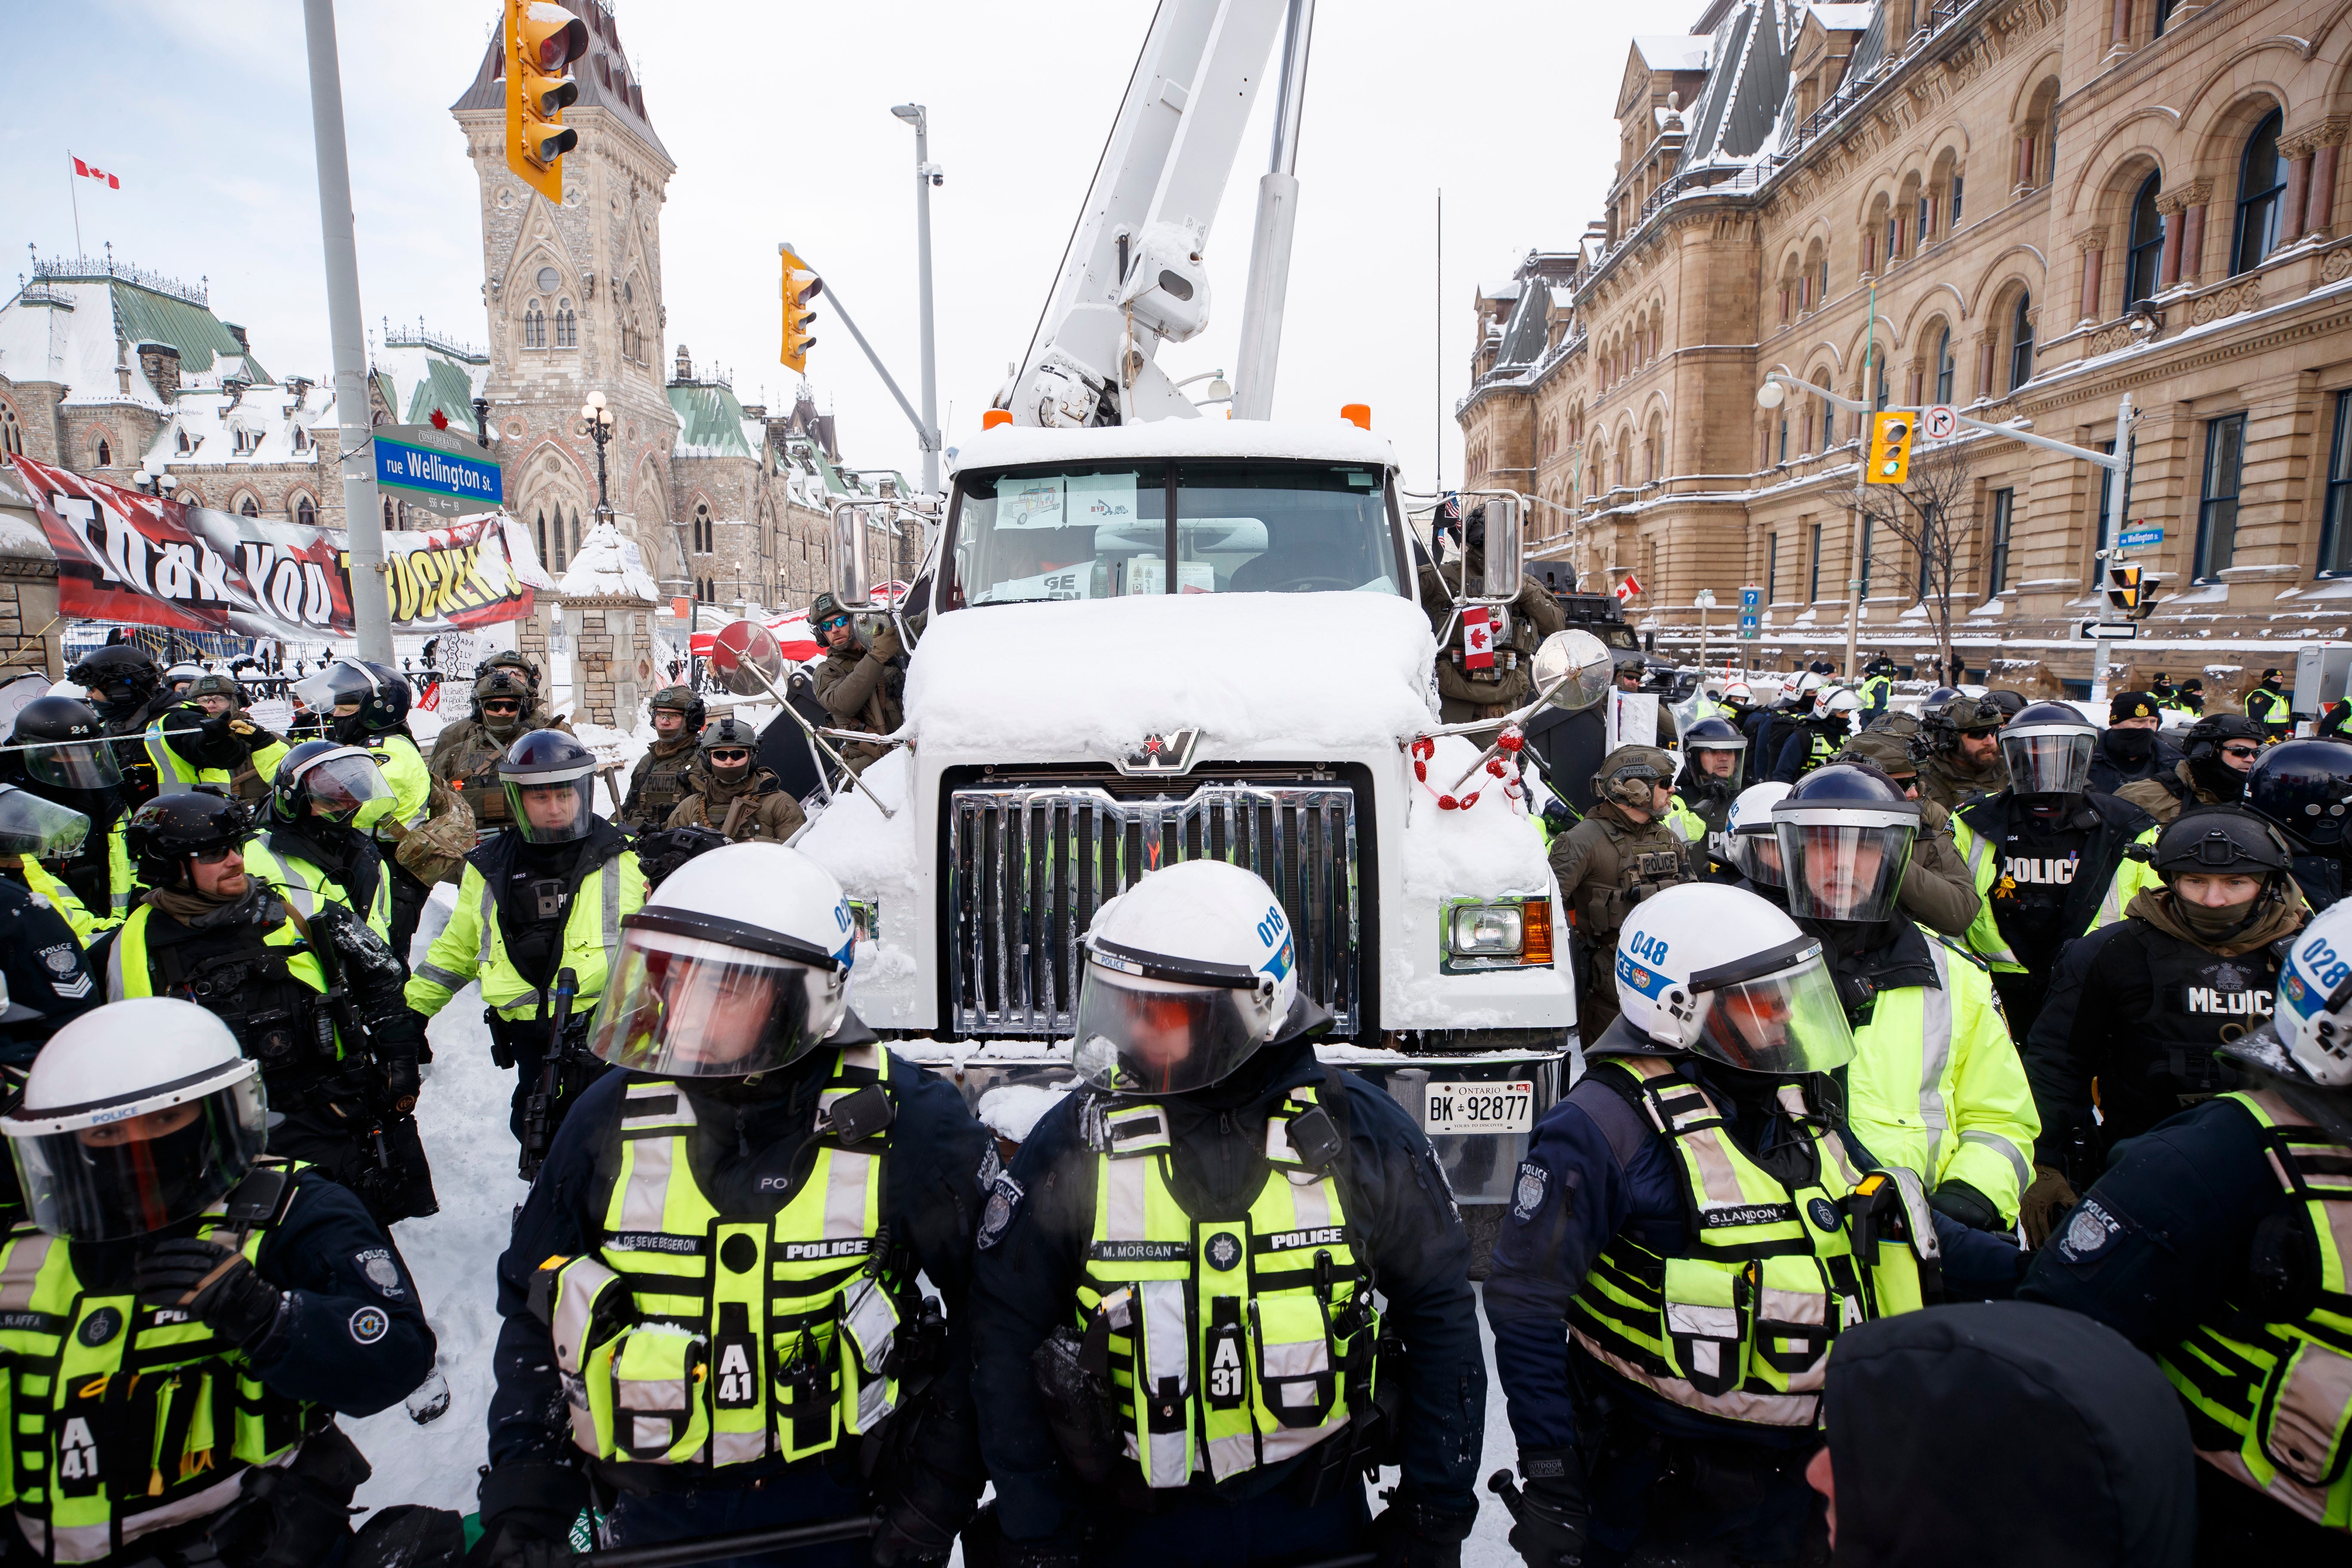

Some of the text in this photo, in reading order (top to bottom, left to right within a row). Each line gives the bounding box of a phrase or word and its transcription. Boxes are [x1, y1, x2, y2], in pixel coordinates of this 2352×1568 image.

[387, 459, 403, 475] rue
[406, 451, 480, 491] Wellington
[429, 497, 459, 511] 556 93
[2128, 533, 2153, 544] Wellington
[70, 725, 89, 735] 24
[646, 776, 676, 793] POLICE
[1645, 855, 1675, 872] POLICE
[2001, 855, 2079, 885] POLIC
[1257, 906, 1284, 948] 018
[39, 942, 72, 957] POLICE
[1630, 930, 1669, 966] 048
[1807, 943, 1821, 957] POLICE
[1101, 956, 1125, 971] POLICE
[2201, 965, 2252, 976] RCMP GRC
[2302, 937, 2350, 989] 028
[2189, 987, 2274, 1016] MEDIC
[1459, 1087, 1501, 1095] ONTARIO
[92, 1106, 138, 1124] POLICE
[1430, 1096, 1528, 1121] BK 92877
[977, 1138, 994, 1179] POLICE
[1521, 1164, 1547, 1182] POLICE
[994, 1181, 1019, 1207] POLICE
[1514, 1204, 1531, 1221] Ottawa
[2082, 1199, 2121, 1234] POLICE
[1271, 1228, 1342, 1249] POLICE
[355, 1249, 391, 1263] POLICE
[787, 1240, 868, 1259] POLICE
[1103, 1245, 1172, 1257] M. MORGAN
[719, 1344, 750, 1375] A
[1213, 1338, 1240, 1368] A
[718, 1372, 752, 1402] 41
[1211, 1367, 1242, 1396] 31
[61, 1417, 95, 1450] A
[61, 1446, 98, 1479] 41
[1528, 1467, 1564, 1476] RESEARCH
